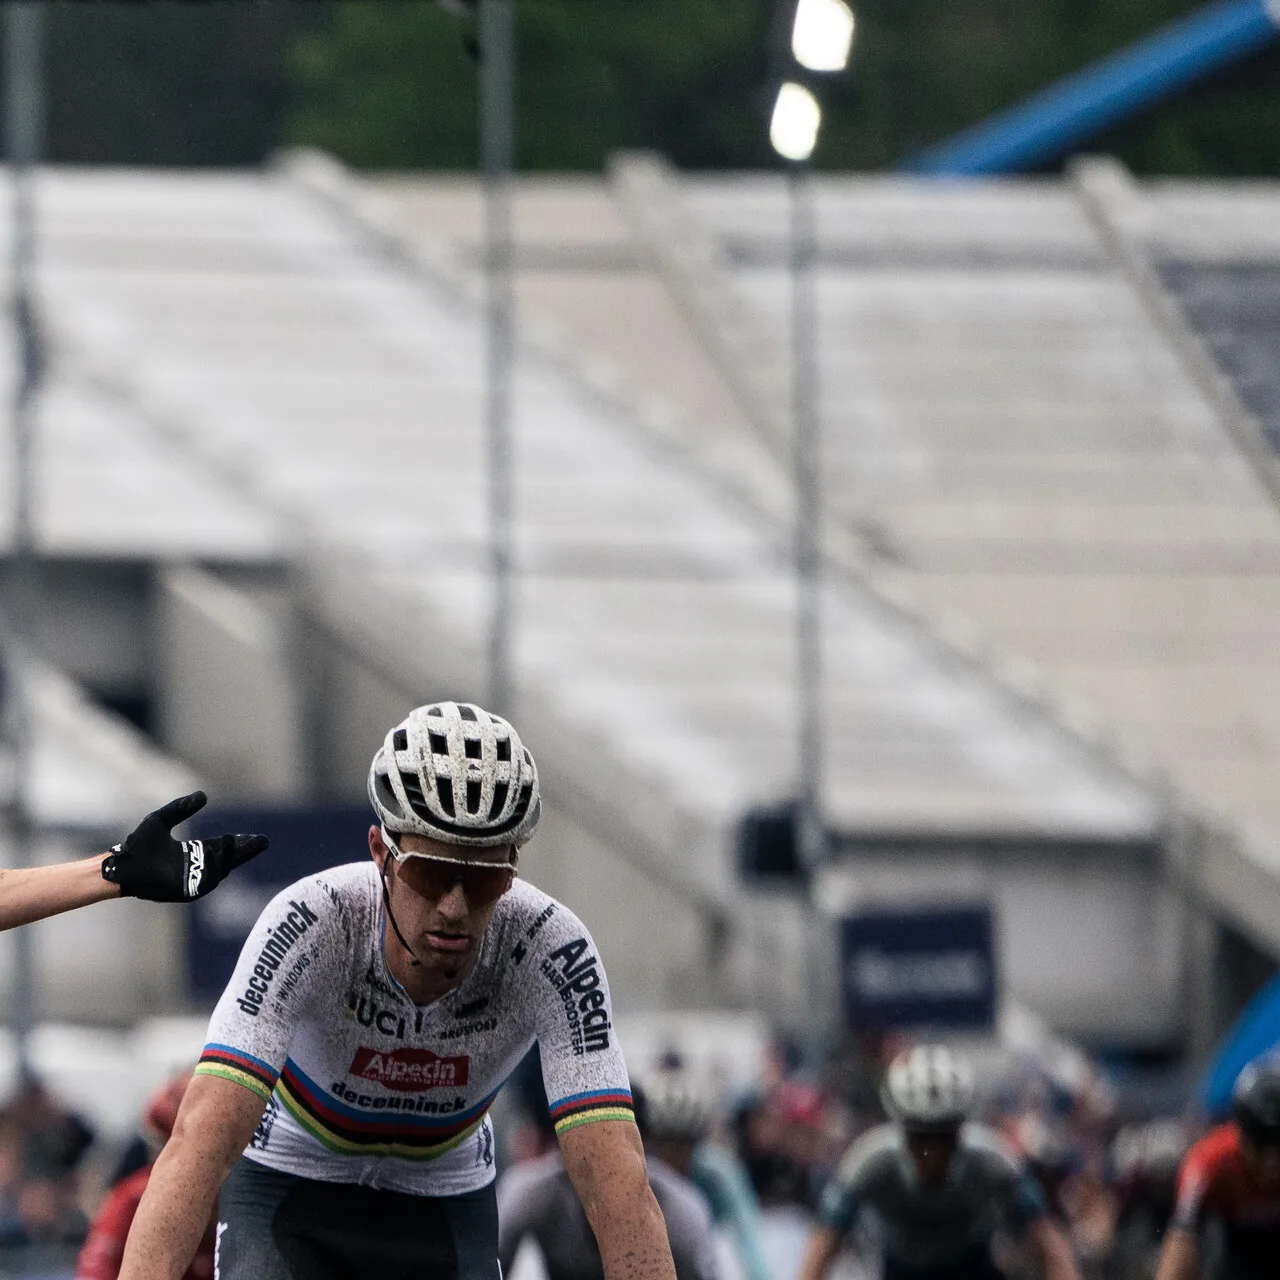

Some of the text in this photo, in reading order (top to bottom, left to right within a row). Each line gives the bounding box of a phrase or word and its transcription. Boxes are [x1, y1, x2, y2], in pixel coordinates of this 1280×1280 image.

[236, 900, 319, 1017] deceuninck
[549, 937, 612, 1054] Alpecin
[331, 1082, 467, 1115] deceuninck
[363, 1054, 456, 1080] Alpecin
